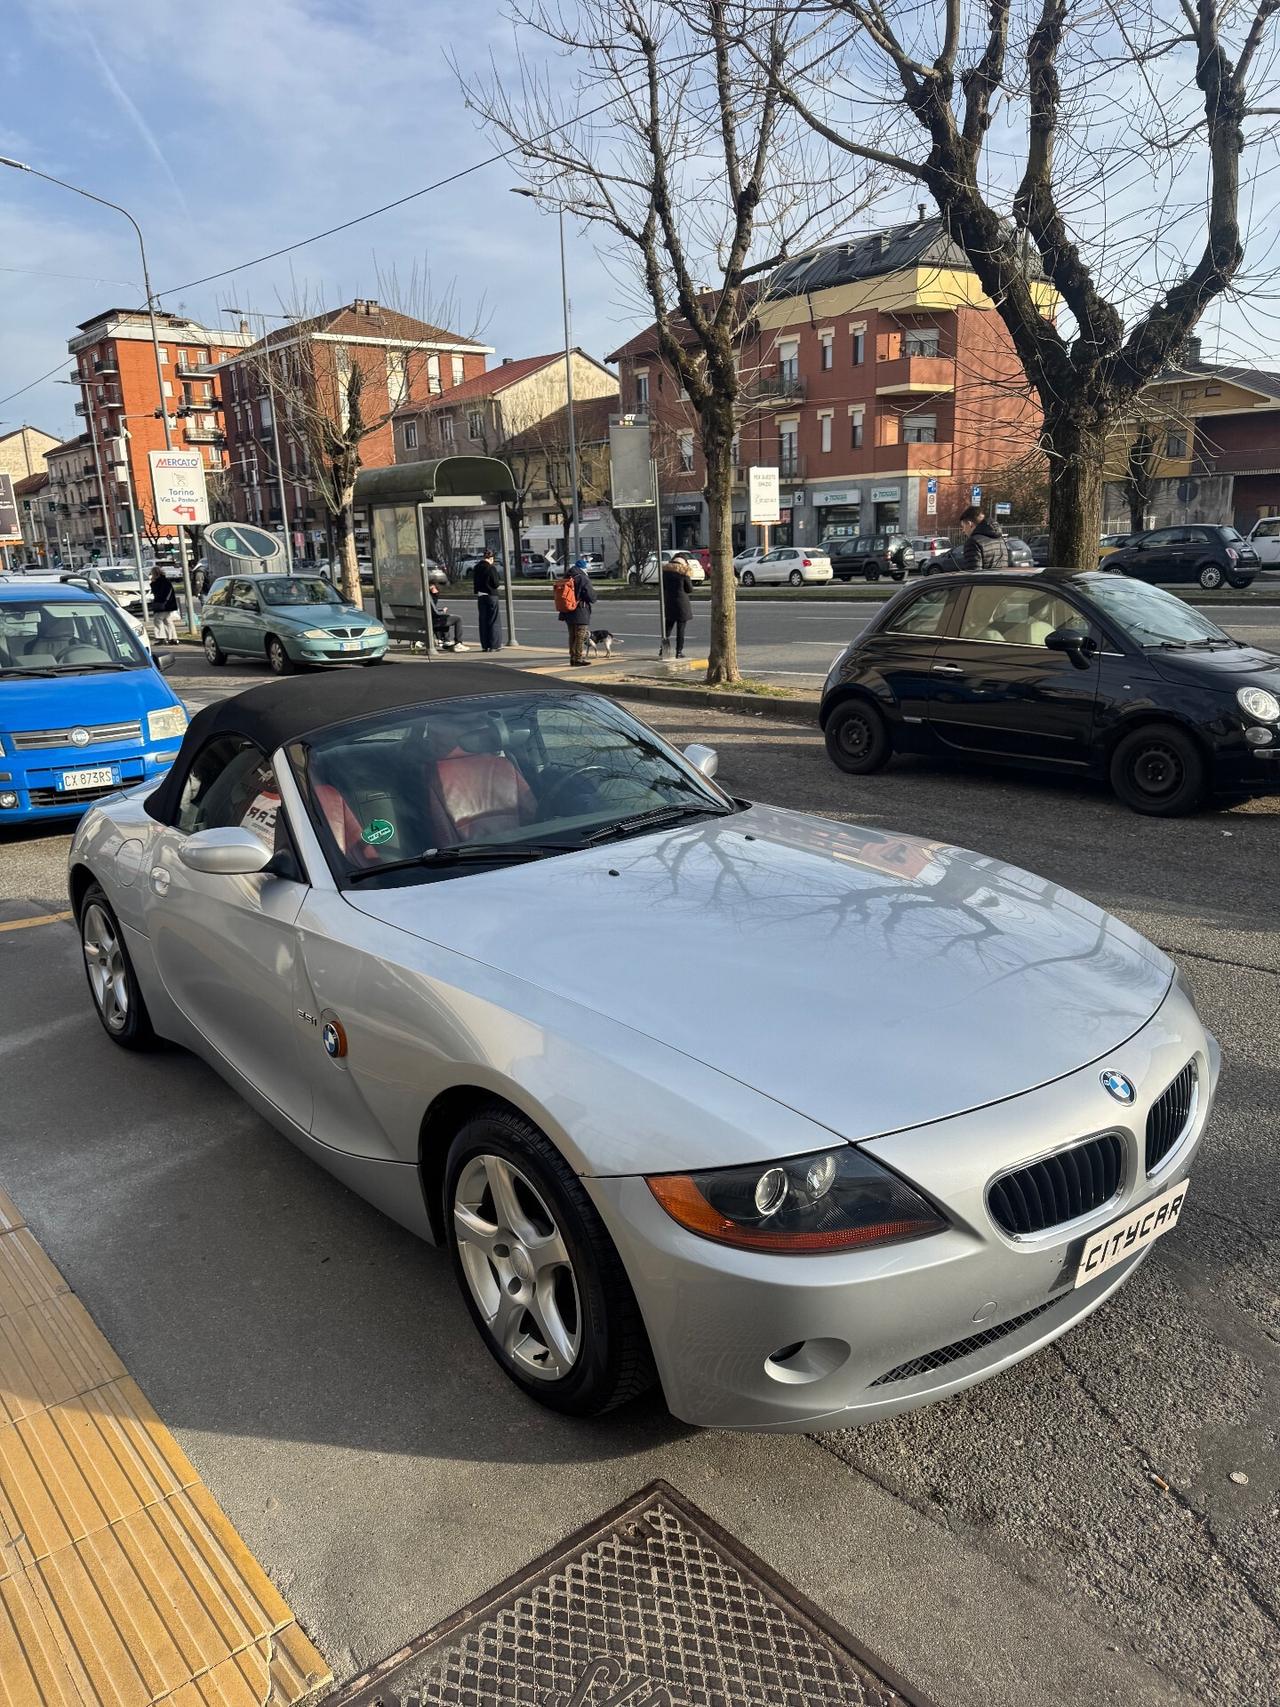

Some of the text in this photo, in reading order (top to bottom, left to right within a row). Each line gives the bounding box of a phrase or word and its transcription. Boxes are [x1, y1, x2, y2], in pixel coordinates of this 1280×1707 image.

[169, 488, 194, 496] Torino
[64, 775, 78, 787] CX
[80, 771, 112, 785] 873RS
[1084, 1193, 1184, 1273] CITYCAR
